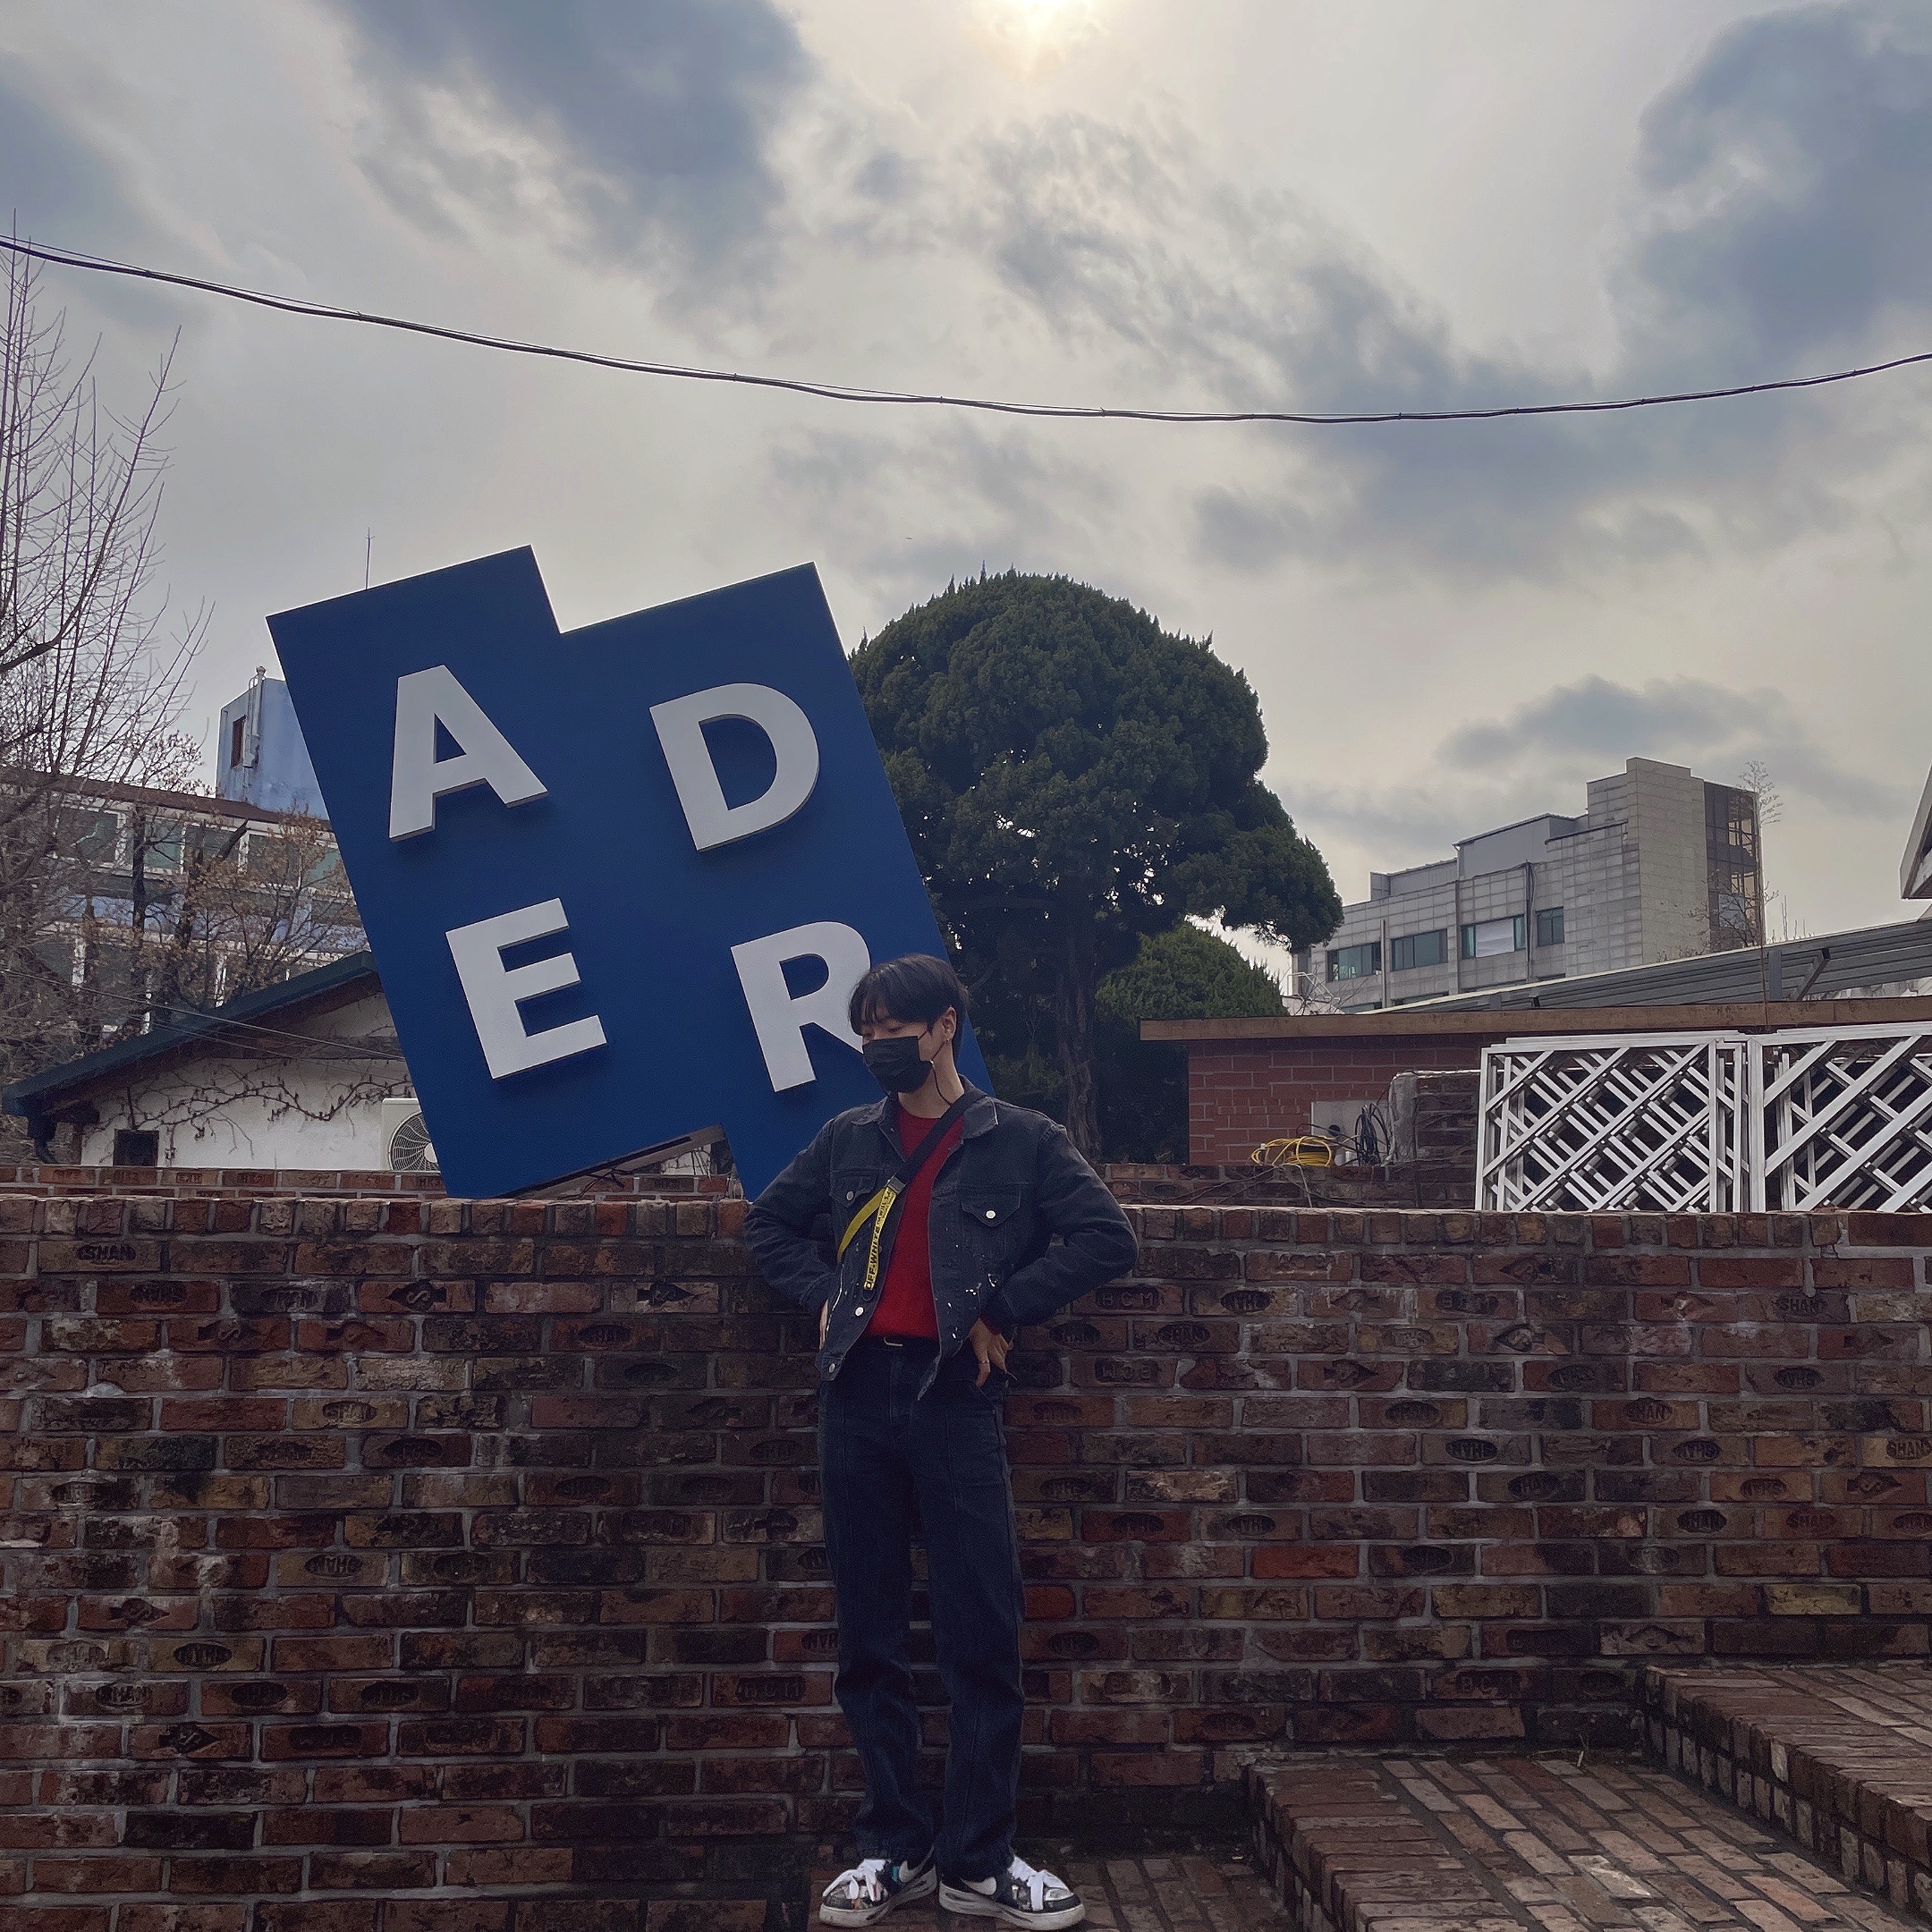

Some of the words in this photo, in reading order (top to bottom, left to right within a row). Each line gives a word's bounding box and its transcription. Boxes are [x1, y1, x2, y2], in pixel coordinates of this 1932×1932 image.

[1102, 1292, 1154, 1308] BCM
[1778, 1298, 1822, 1316] SHAN
[1886, 1441, 1926, 1458] SHAN
